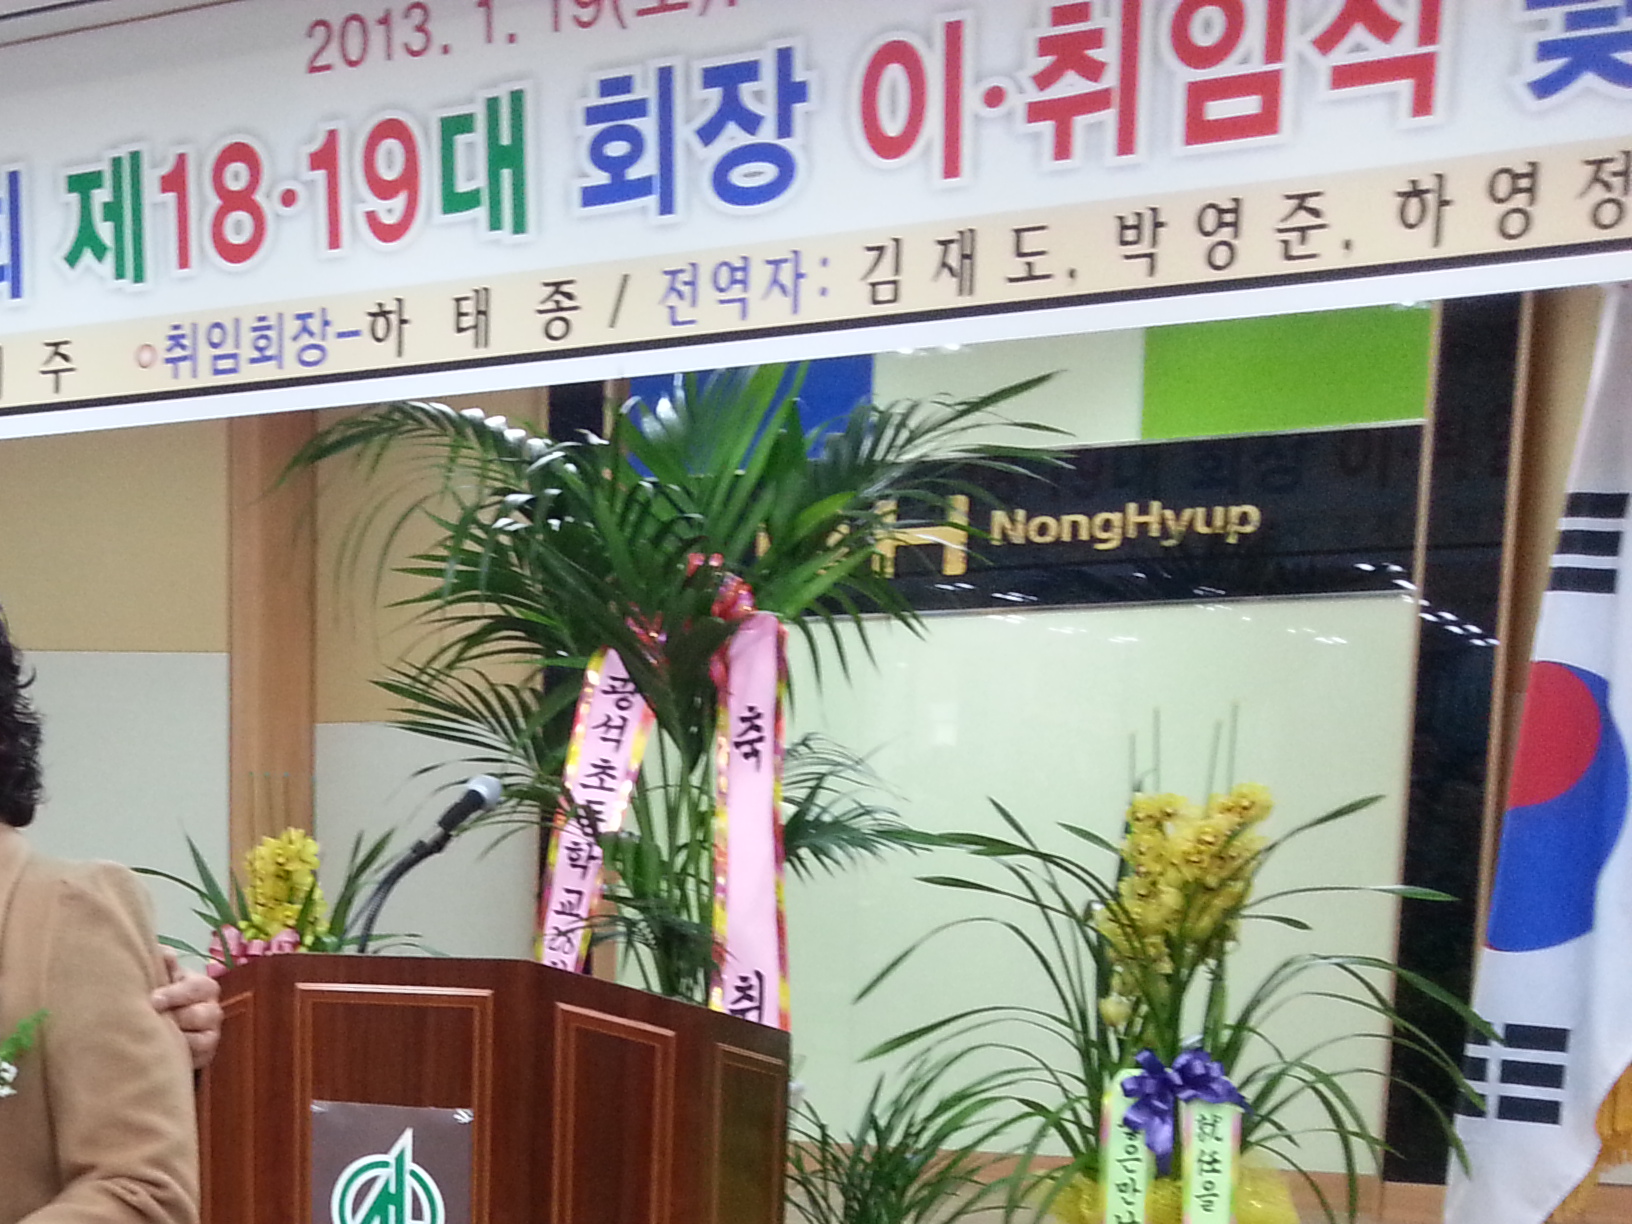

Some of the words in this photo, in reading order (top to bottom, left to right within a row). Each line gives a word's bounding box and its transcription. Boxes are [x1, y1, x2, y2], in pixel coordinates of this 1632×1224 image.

[307, 1, 451, 74] 2013.
[579, 46, 808, 217] 회장
[990, 500, 1262, 551] NongHyup
[733, 705, 767, 772] 축
